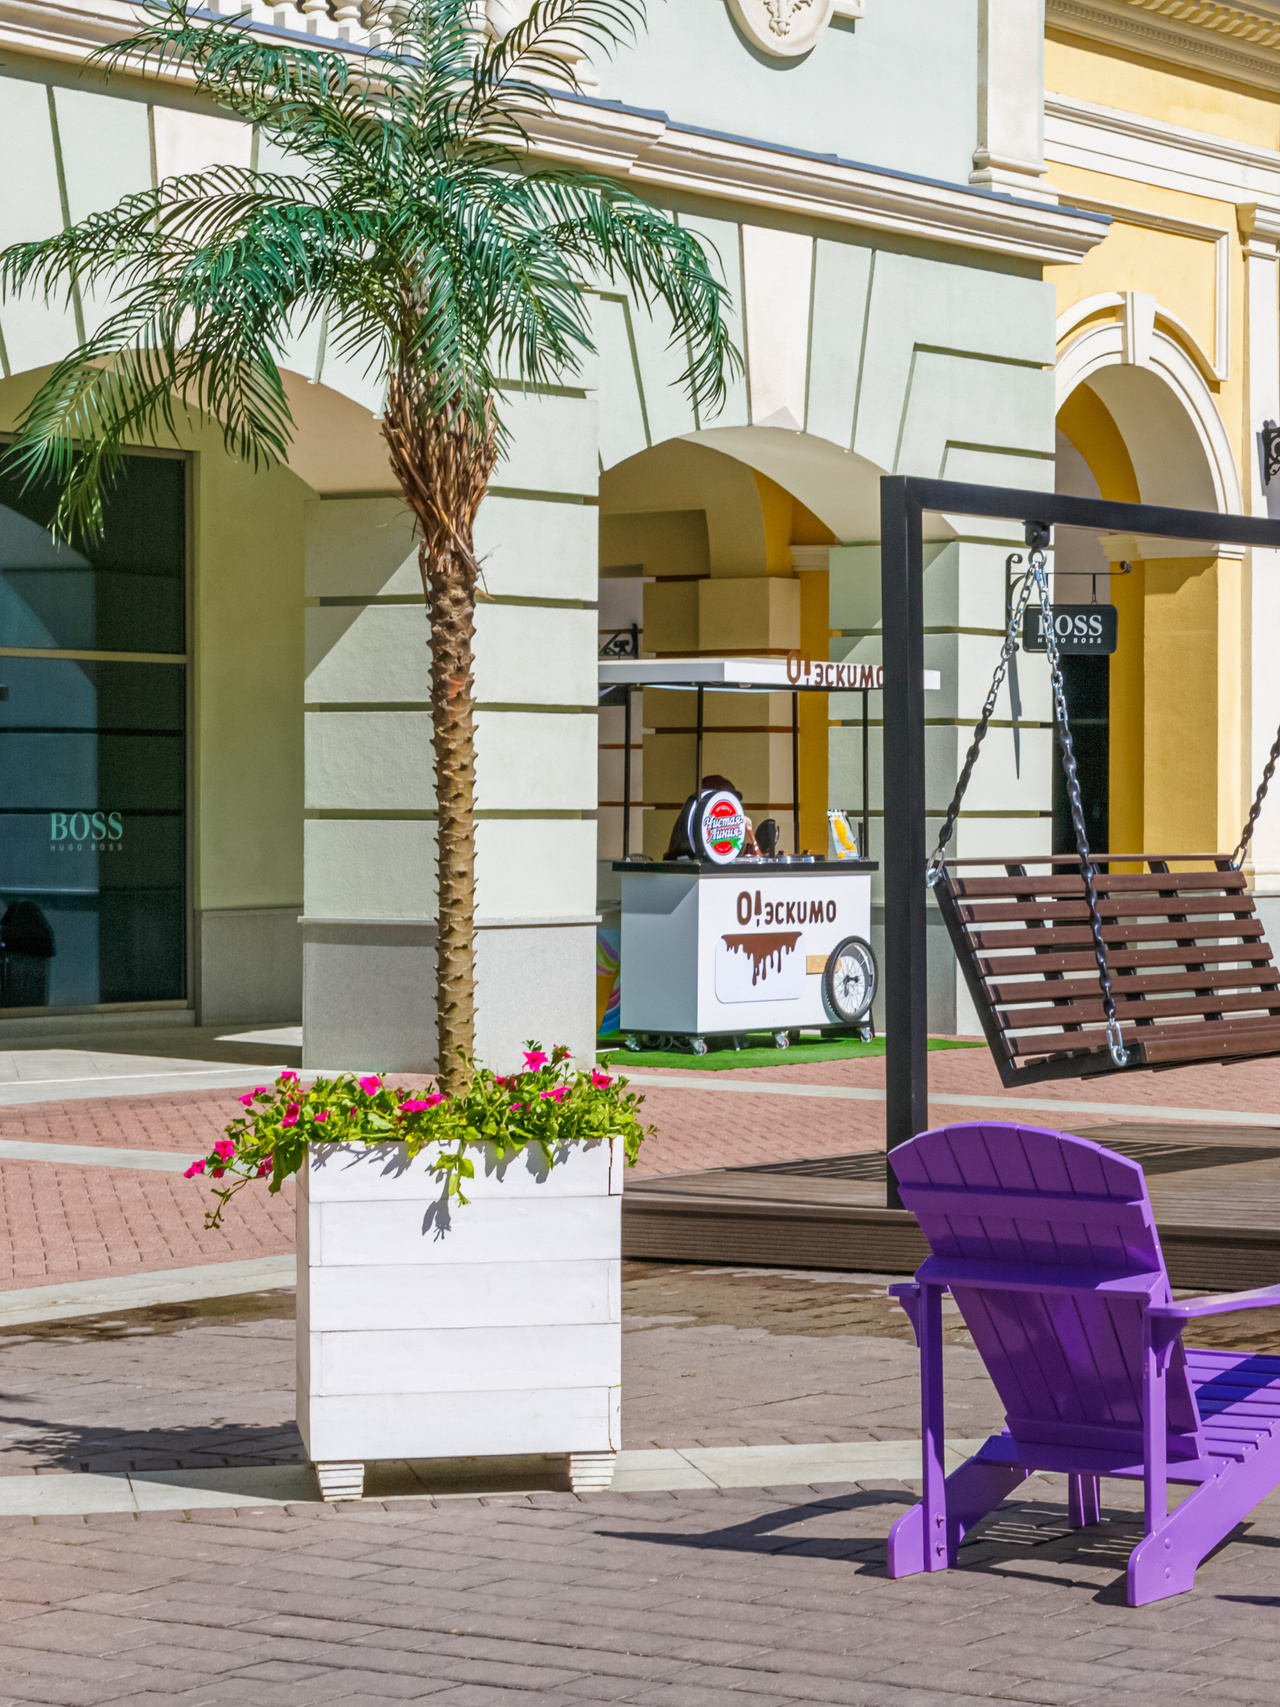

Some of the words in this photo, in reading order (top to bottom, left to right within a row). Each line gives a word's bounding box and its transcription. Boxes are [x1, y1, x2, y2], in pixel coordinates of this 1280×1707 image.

[50, 811, 123, 841] BOSS
[703, 815, 744, 830] Чистая
[706, 828, 742, 843] Линия
[50, 843, 83, 852] HUGO
[91, 843, 123, 852] BOSS
